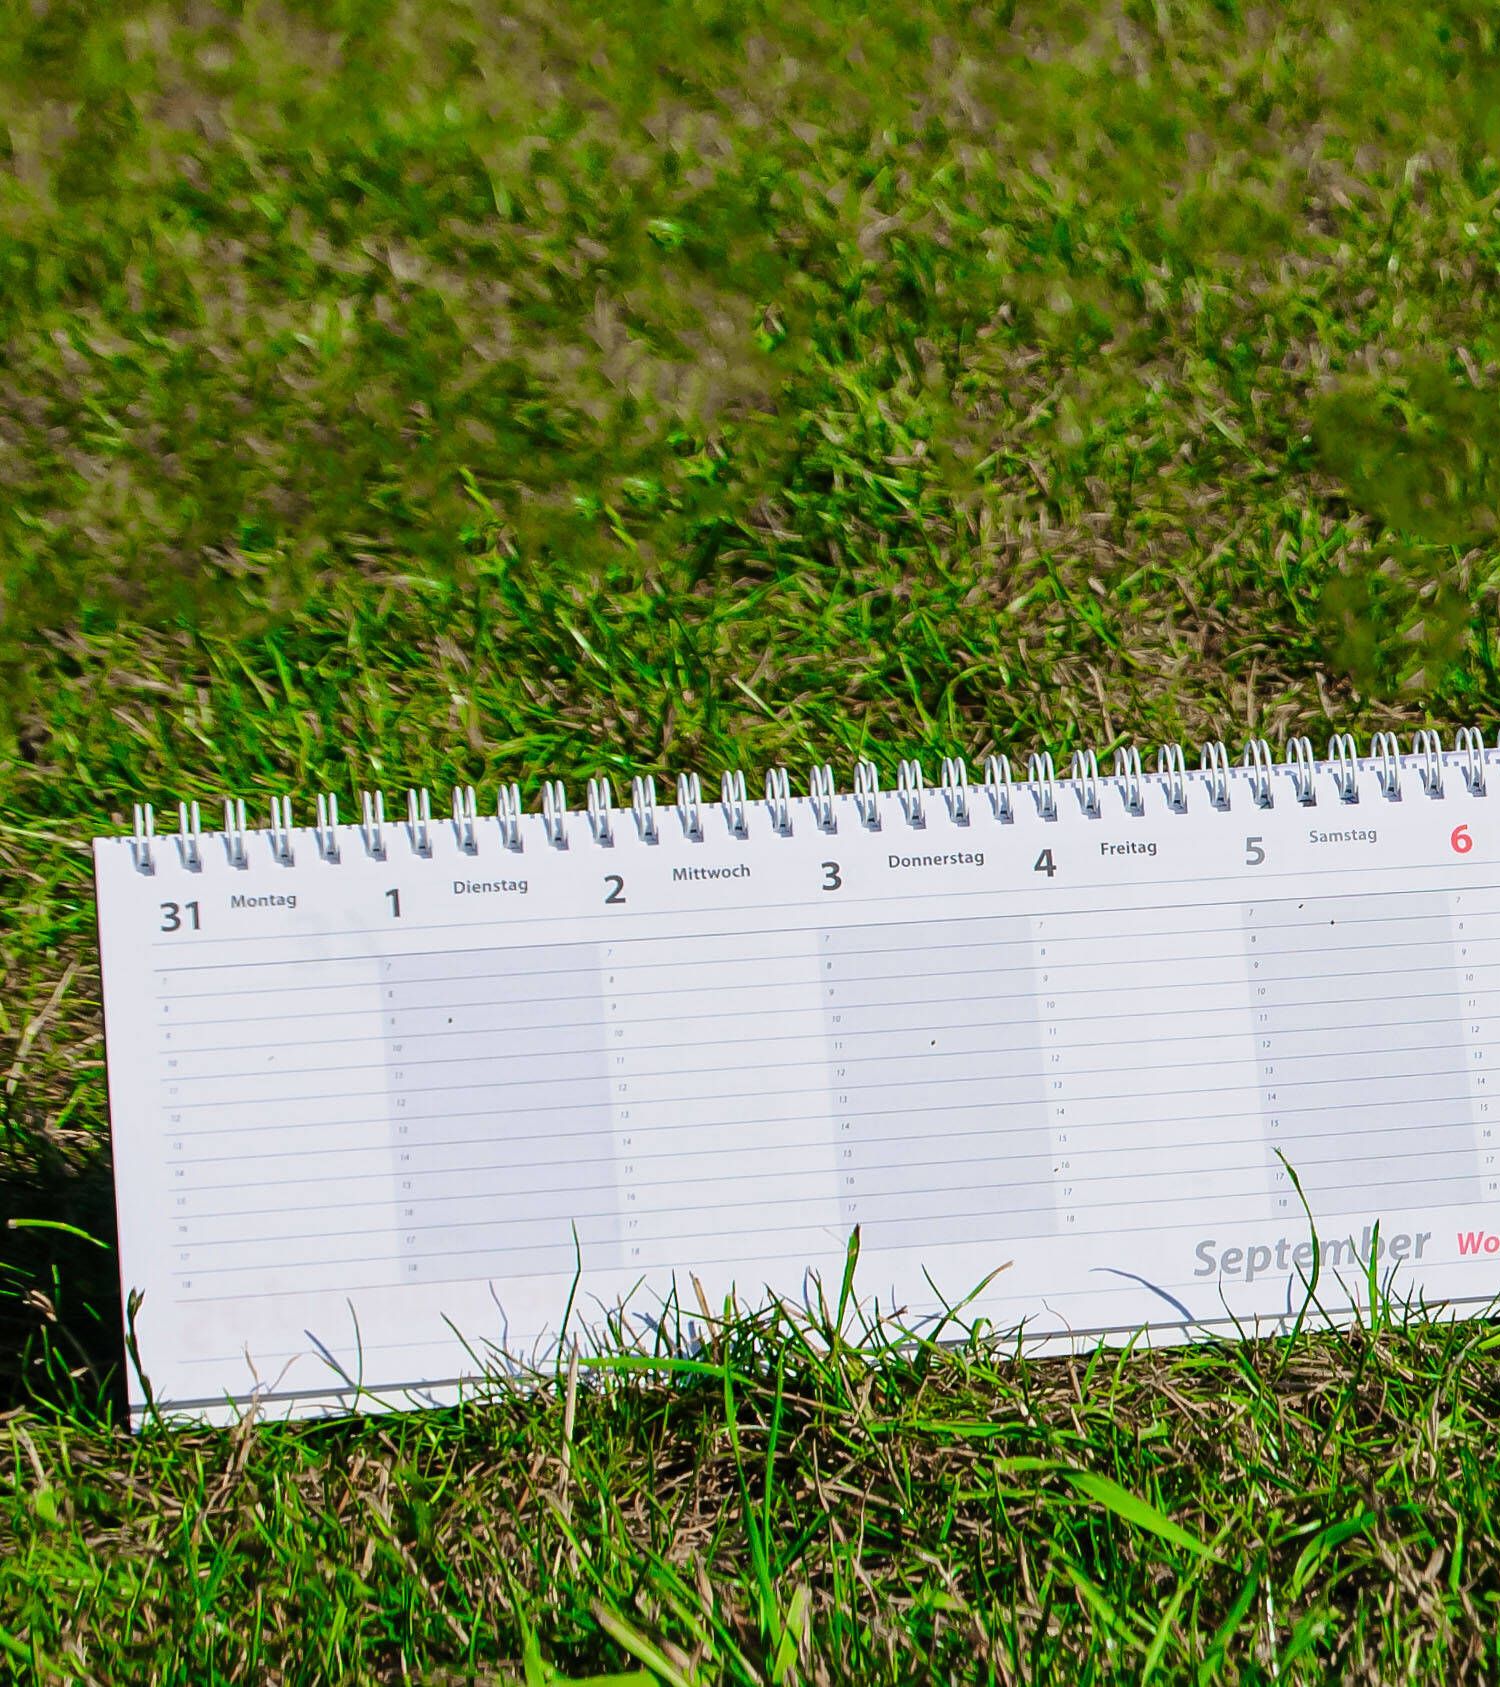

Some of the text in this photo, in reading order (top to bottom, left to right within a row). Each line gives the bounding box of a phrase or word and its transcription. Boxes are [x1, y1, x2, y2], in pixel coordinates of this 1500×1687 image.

[1450, 824, 1473, 854] 6
[1245, 828, 1377, 866] 5 Samstag
[1033, 840, 1158, 878] 4 Freitag
[821, 850, 985, 891] 3 Donnerstag
[604, 863, 751, 904] 2 Mittwoch
[384, 878, 529, 918] 1 Dienstag
[160, 892, 297, 933] 31 Montag
[1465, 973, 1474, 982] 10
[1257, 987, 1266, 996] 10
[1468, 999, 1476, 1009] 11
[1258, 1013, 1268, 1023] 11
[1471, 1025, 1481, 1034] 12
[1262, 1039, 1272, 1049] 12
[1473, 1050, 1483, 1060] 13
[1264, 1065, 1274, 1076] 13
[1476, 1076, 1486, 1086] 14
[1267, 1092, 1277, 1102] 14
[1480, 1103, 1489, 1113] 15
[1270, 1119, 1280, 1128] 15
[1482, 1129, 1492, 1138] 16
[1485, 1154, 1496, 1165] 17
[1275, 1171, 1285, 1182] 17
[1488, 1181, 1498, 1191] 18
[1278, 1198, 1288, 1208] 18
[1193, 1226, 1432, 1283] September
